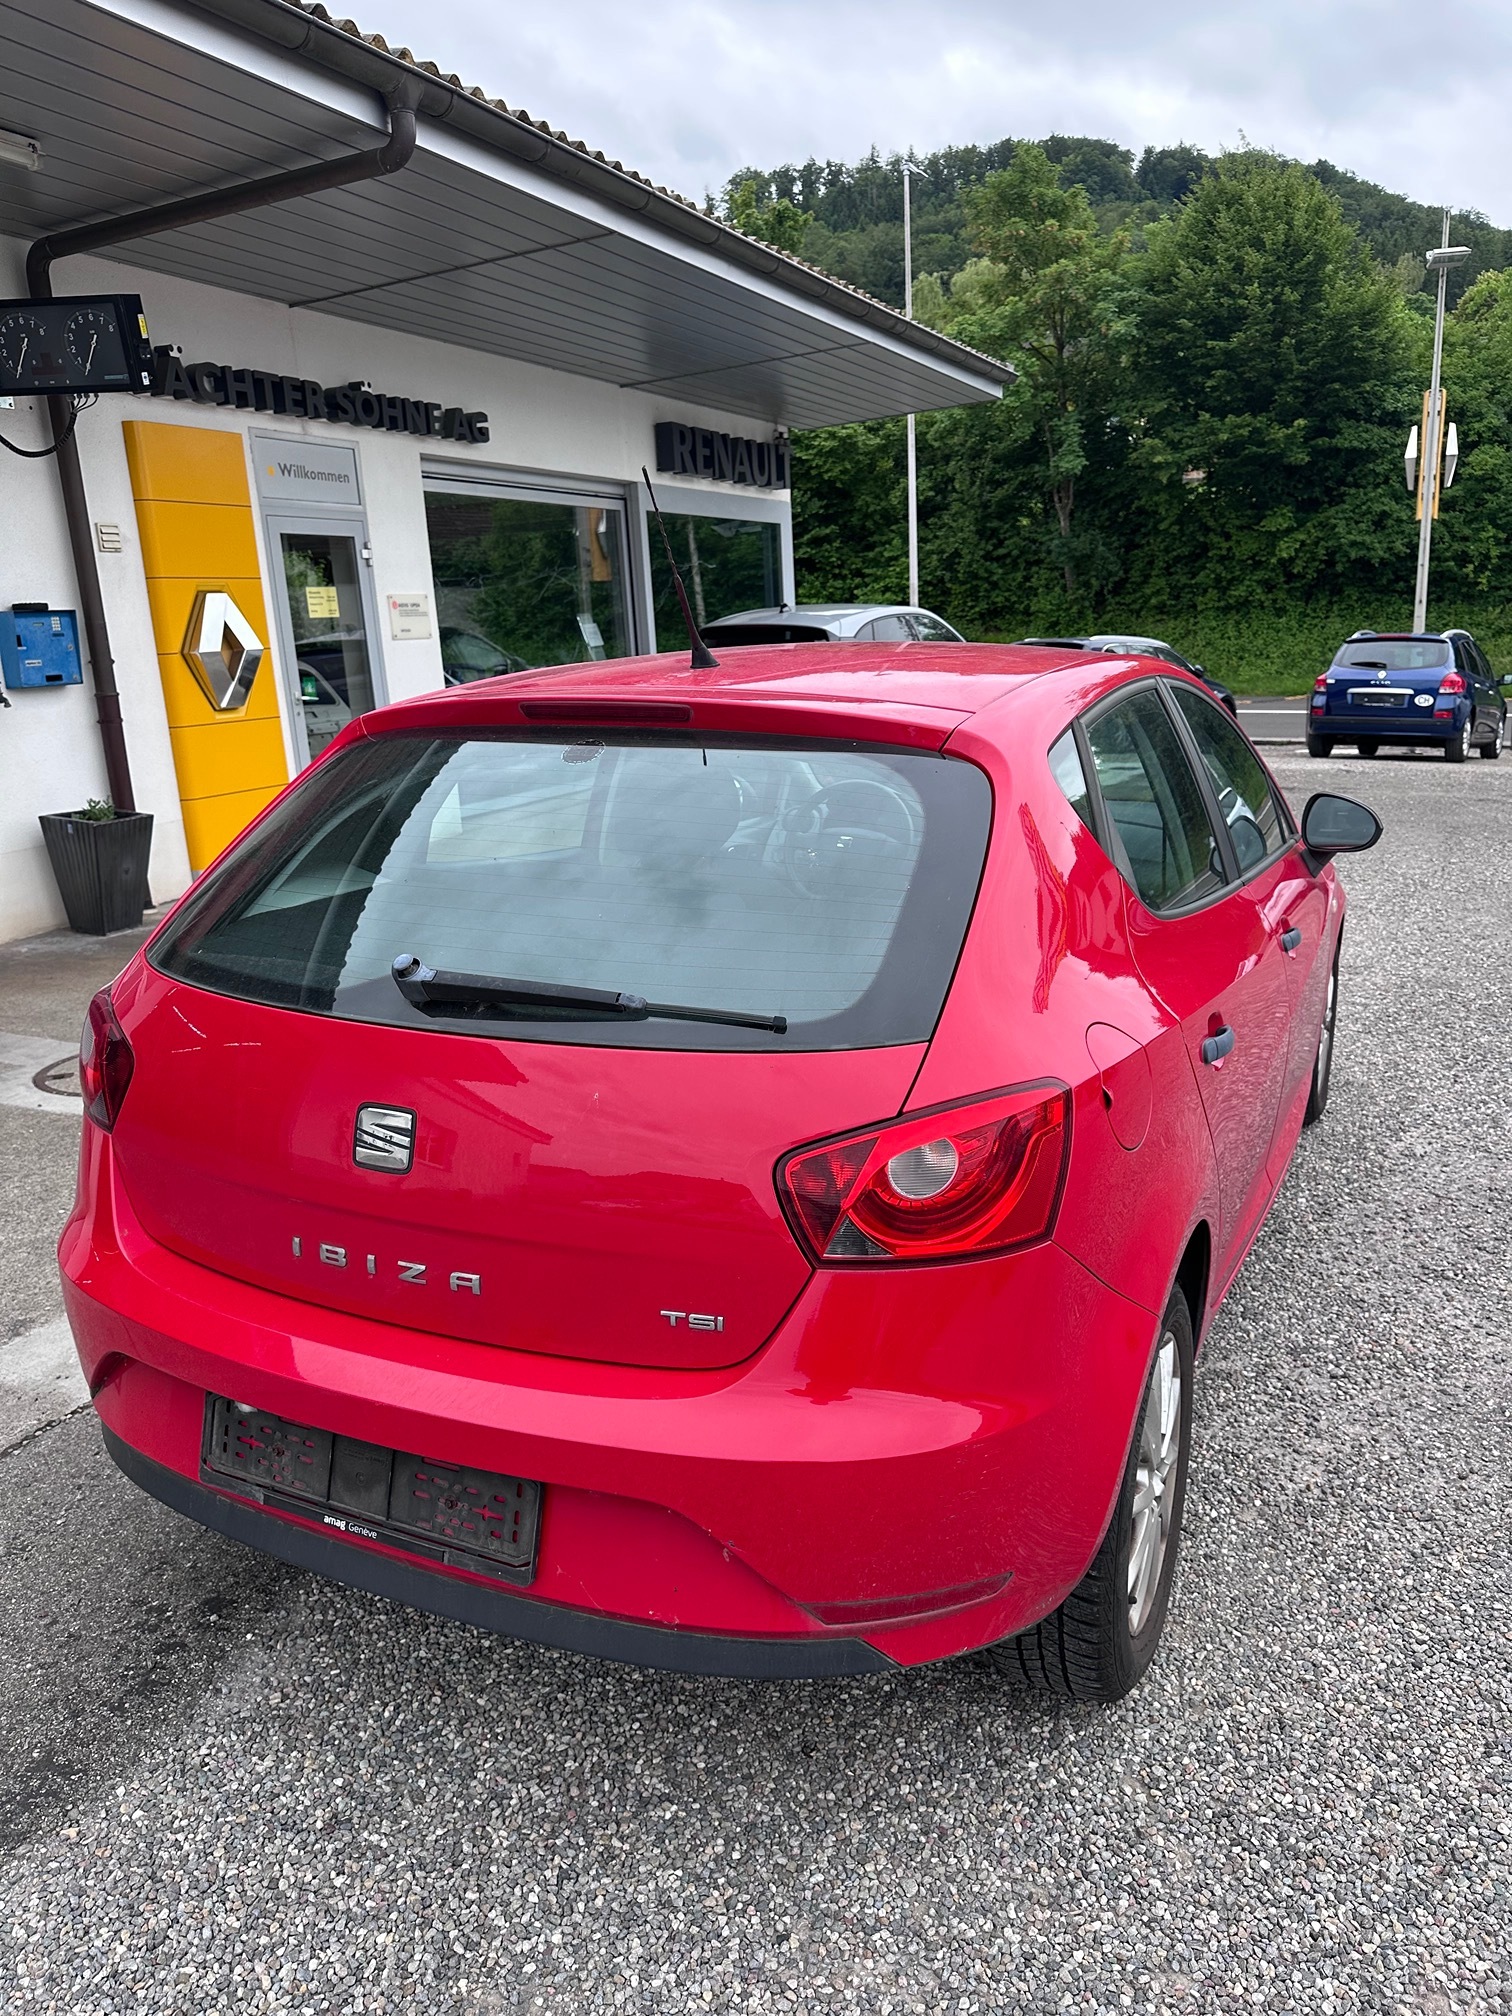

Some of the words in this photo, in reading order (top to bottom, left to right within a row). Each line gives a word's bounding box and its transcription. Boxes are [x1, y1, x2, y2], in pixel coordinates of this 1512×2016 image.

[446, 407, 490, 444] AG
[663, 421, 793, 490] RENAULT
[277, 462, 351, 484] Willkommen
[1417, 697, 1430, 705] CH
[291, 1235, 482, 1296] IBIZA
[659, 1309, 725, 1333] TSI
[323, 1515, 346, 1530] amag
[348, 1522, 378, 1539] Genève
